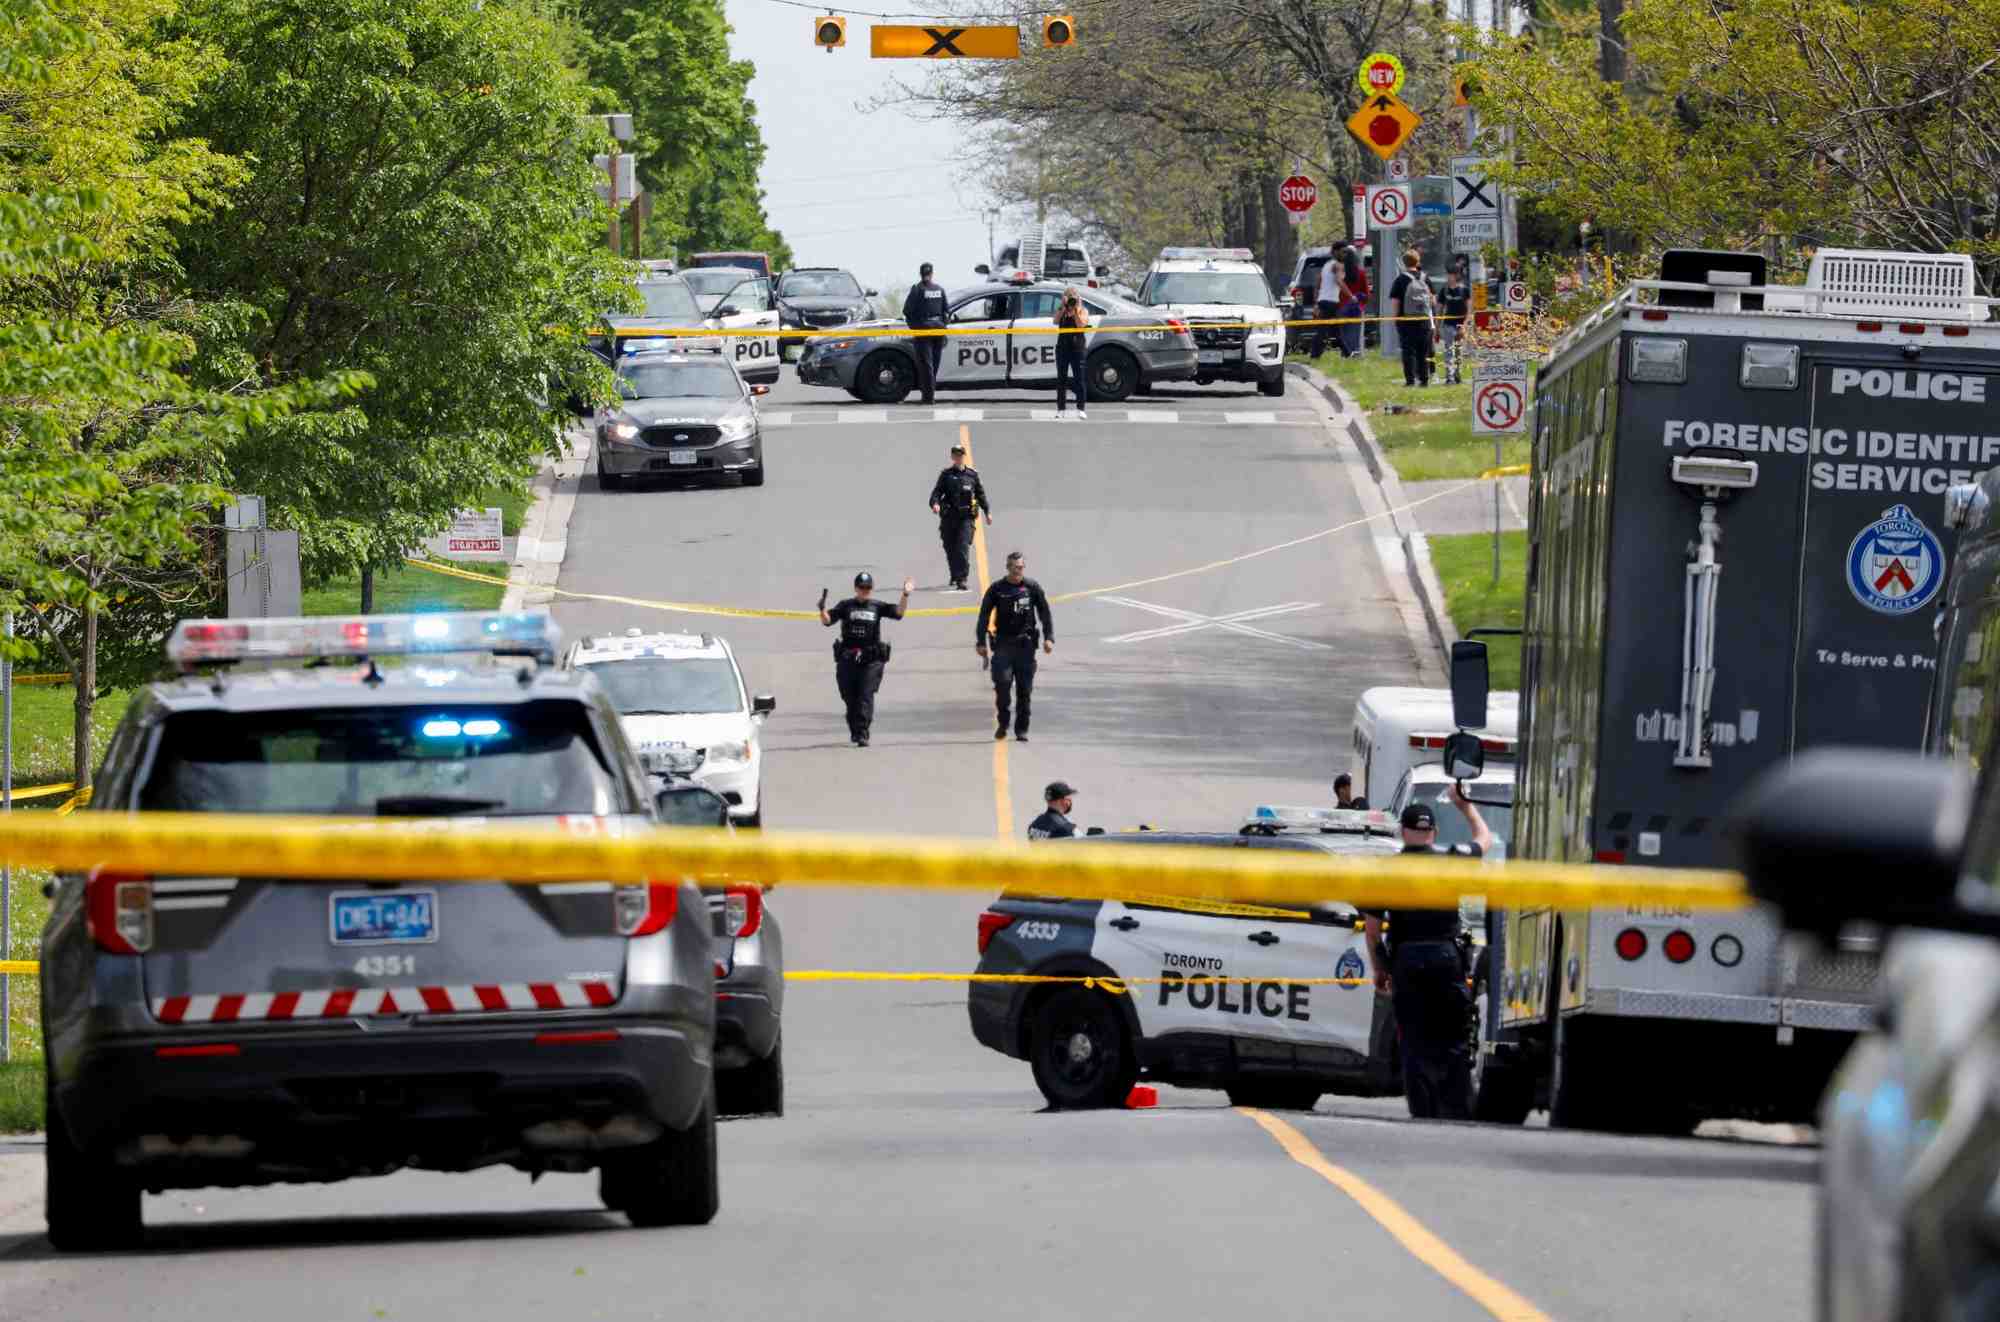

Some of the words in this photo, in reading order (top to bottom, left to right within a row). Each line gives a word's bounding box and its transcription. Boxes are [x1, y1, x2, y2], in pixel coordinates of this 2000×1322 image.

[1369, 68, 1396, 84] NEW
[1281, 187, 1315, 202] STOP
[958, 346, 1056, 366] POLICE
[1831, 368, 1986, 402] POLICE
[1663, 420, 1848, 455] FORENSIC
[1816, 649, 1837, 663] To
[1841, 650, 1888, 667] Serve
[1893, 653, 1906, 668] &
[1016, 920, 1061, 940] 4333
[353, 955, 415, 976] 4351
[1163, 952, 1223, 970] TORONTO
[1157, 970, 1311, 1021] POLICE
